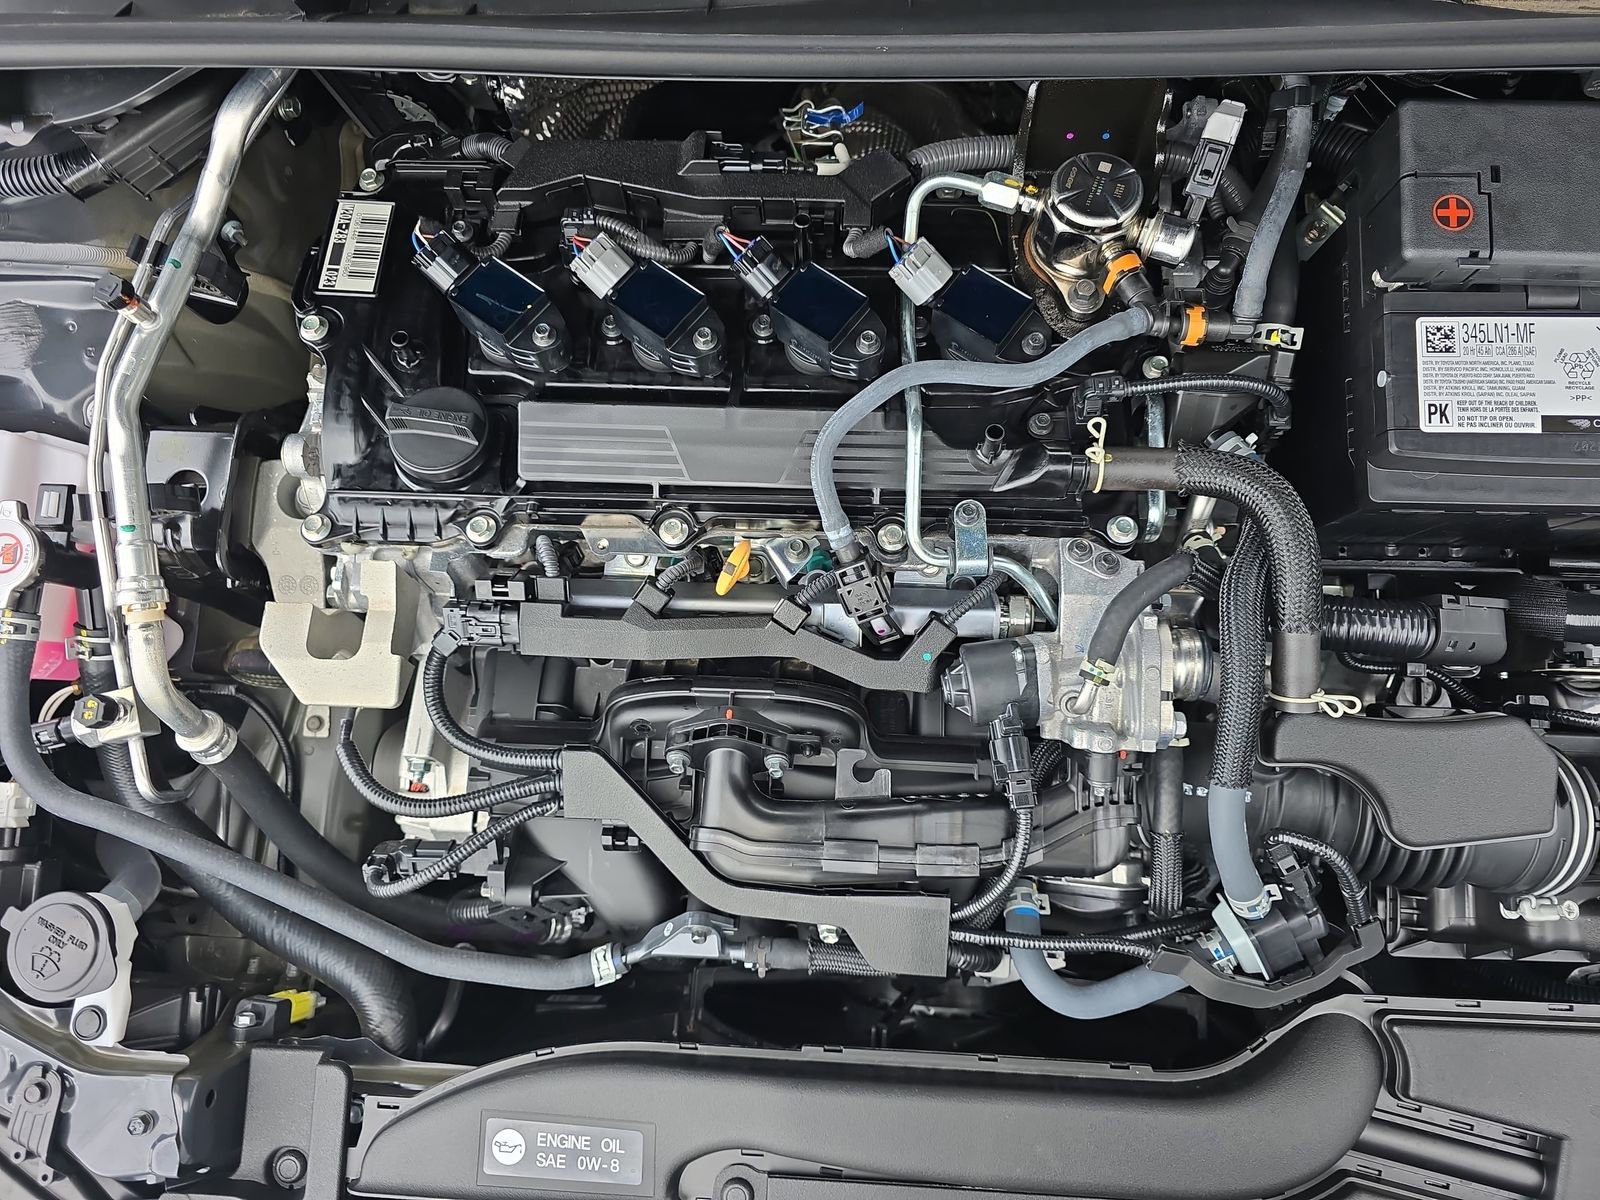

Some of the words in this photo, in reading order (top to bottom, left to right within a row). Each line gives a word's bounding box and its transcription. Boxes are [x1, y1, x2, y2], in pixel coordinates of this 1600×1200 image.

[324, 270, 338, 286] 023
[1462, 323, 1535, 343] 345LN1-MF
[1463, 346, 1469, 356] 20
[1478, 346, 1484, 356] 45
[1496, 346, 1505, 356] CCA
[1428, 404, 1450, 424] PK
[38, 916, 66, 938] WASHER
[67, 934, 88, 951] FLUID
[48, 935, 68, 949] ONLY
[537, 1132, 591, 1150] ENGINE
[601, 1138, 625, 1154] OIL
[536, 1152, 566, 1168] SAE
[577, 1156, 620, 1172] 0W-8
